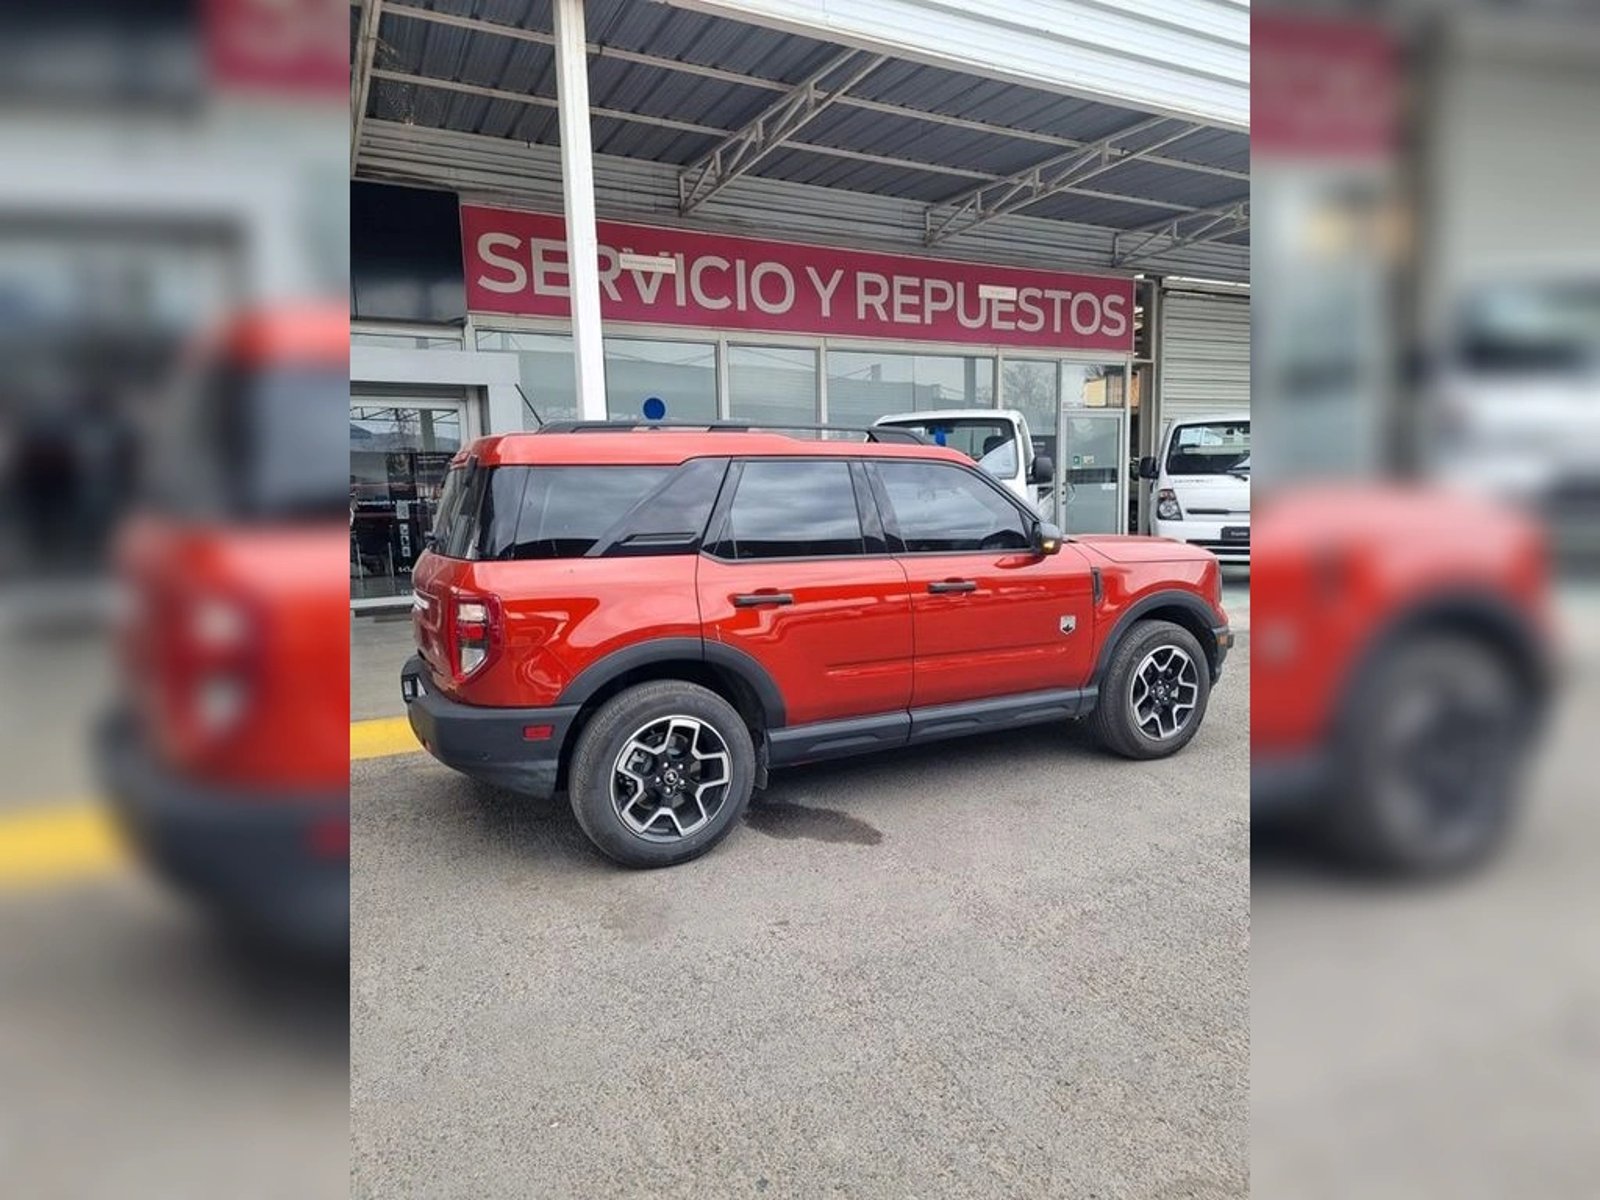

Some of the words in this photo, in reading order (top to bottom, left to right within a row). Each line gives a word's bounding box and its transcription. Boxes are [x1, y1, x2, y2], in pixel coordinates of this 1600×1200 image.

[477, 232, 795, 314] SERVICIO
[806, 266, 844, 317] Y
[856, 272, 1126, 337] REPUESTOS
